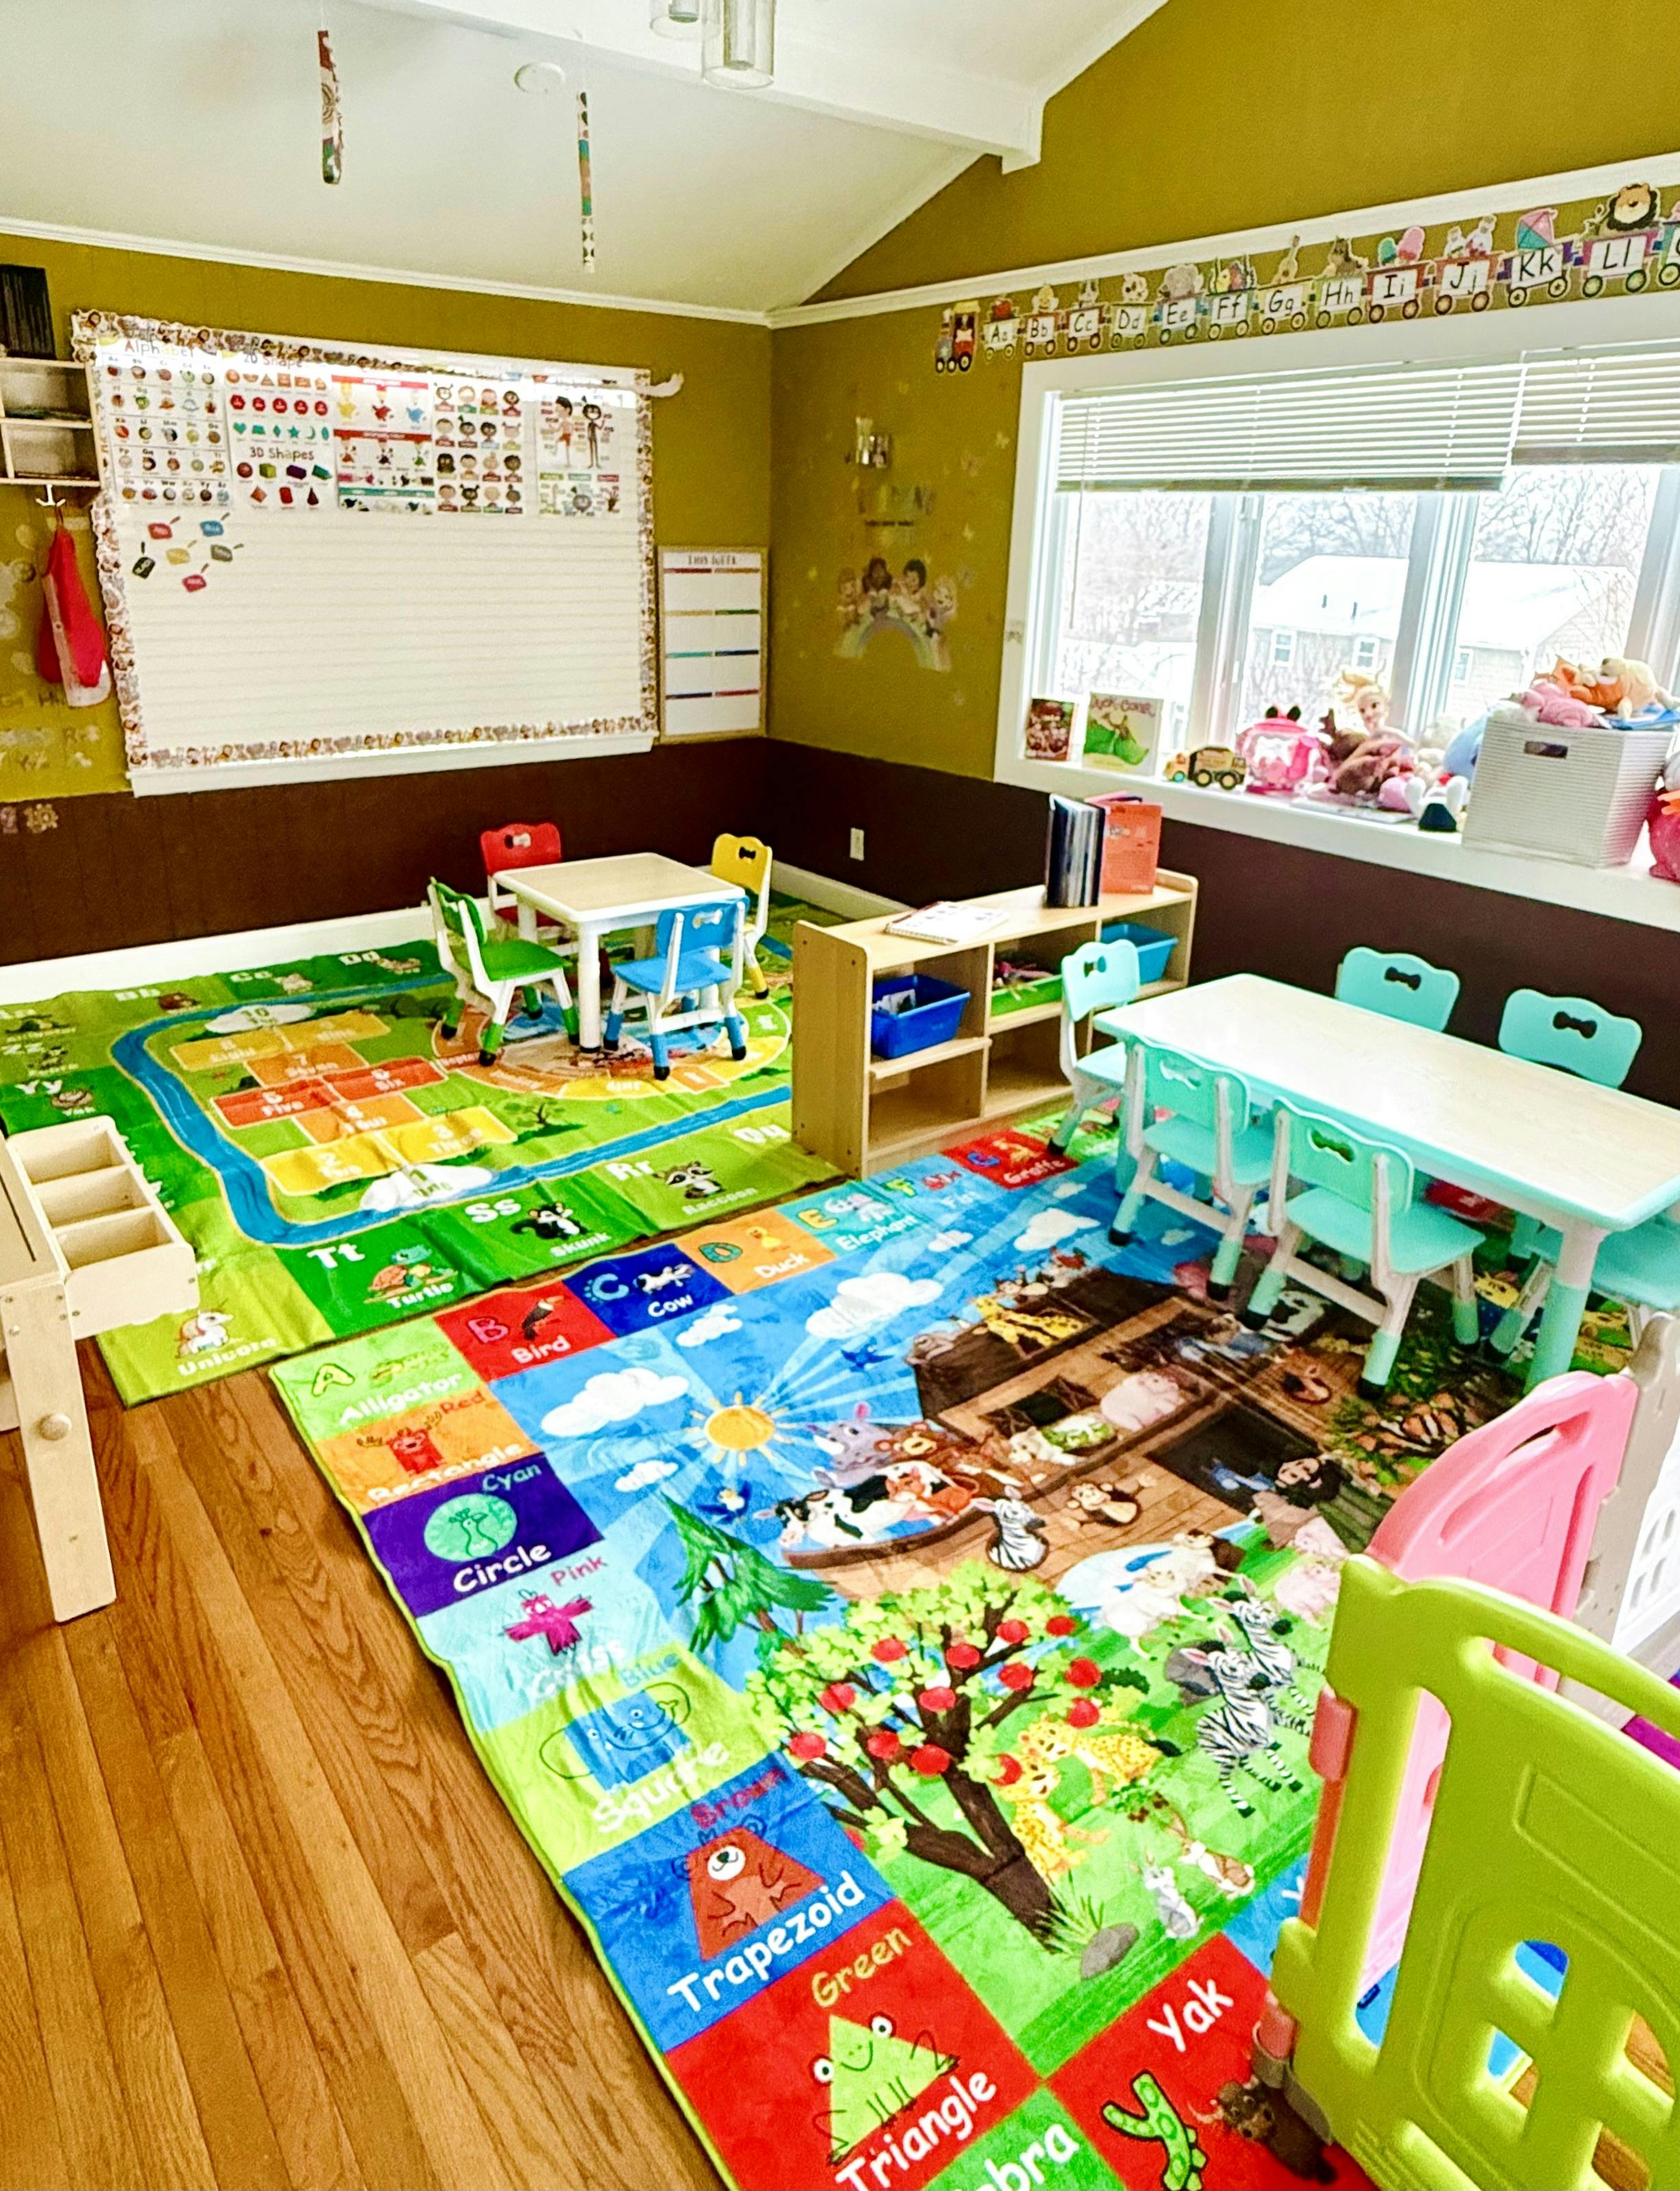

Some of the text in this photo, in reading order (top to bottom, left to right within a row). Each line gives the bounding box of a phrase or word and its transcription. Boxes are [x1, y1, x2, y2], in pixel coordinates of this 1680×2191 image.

[1031, 318, 1048, 337] Bb
[1074, 314, 1092, 332] Cc
[1118, 310, 1139, 329] Dd
[1167, 304, 1188, 325] Ee
[1217, 298, 1240, 320] Ff
[1269, 290, 1294, 317] Gg
[1325, 283, 1354, 304] Hh
[1384, 274, 1405, 298] Ii
[1451, 262, 1478, 294] Jj
[1520, 248, 1554, 281] Kk
[250, 447, 315, 462] 3D Shapes
[291, 1053, 308, 1066] 7
[14, 1079, 63, 1095] Yy
[262, 1100, 304, 1117] Five
[604, 1159, 655, 1181] Rr
[1003, 1160, 1066, 1184] Giraffe
[464, 1198, 522, 1223] Ss
[795, 1208, 839, 1230] E
[550, 1232, 613, 1257] Skunk
[836, 1214, 920, 1250] Elephant
[307, 1243, 366, 1269] Tt
[753, 1252, 812, 1279] Duck
[386, 1281, 454, 1310] Turtle
[584, 1273, 630, 1302] C
[647, 1293, 694, 1318] Cow
[467, 1315, 509, 1344] B
[178, 1337, 277, 1376] Unicorn
[510, 1334, 572, 1364] Bird
[311, 1362, 356, 1398] A
[340, 1372, 463, 1425] Alligator
[481, 1463, 543, 1492] Cyan
[453, 1542, 553, 1594] Circle
[550, 1554, 608, 1587] Pink
[667, 1869, 866, 2013] Trapezoid
[811, 1926, 913, 2009] Green
[1146, 1978, 1235, 2052] Yak
[835, 2071, 998, 2191] Triangle
